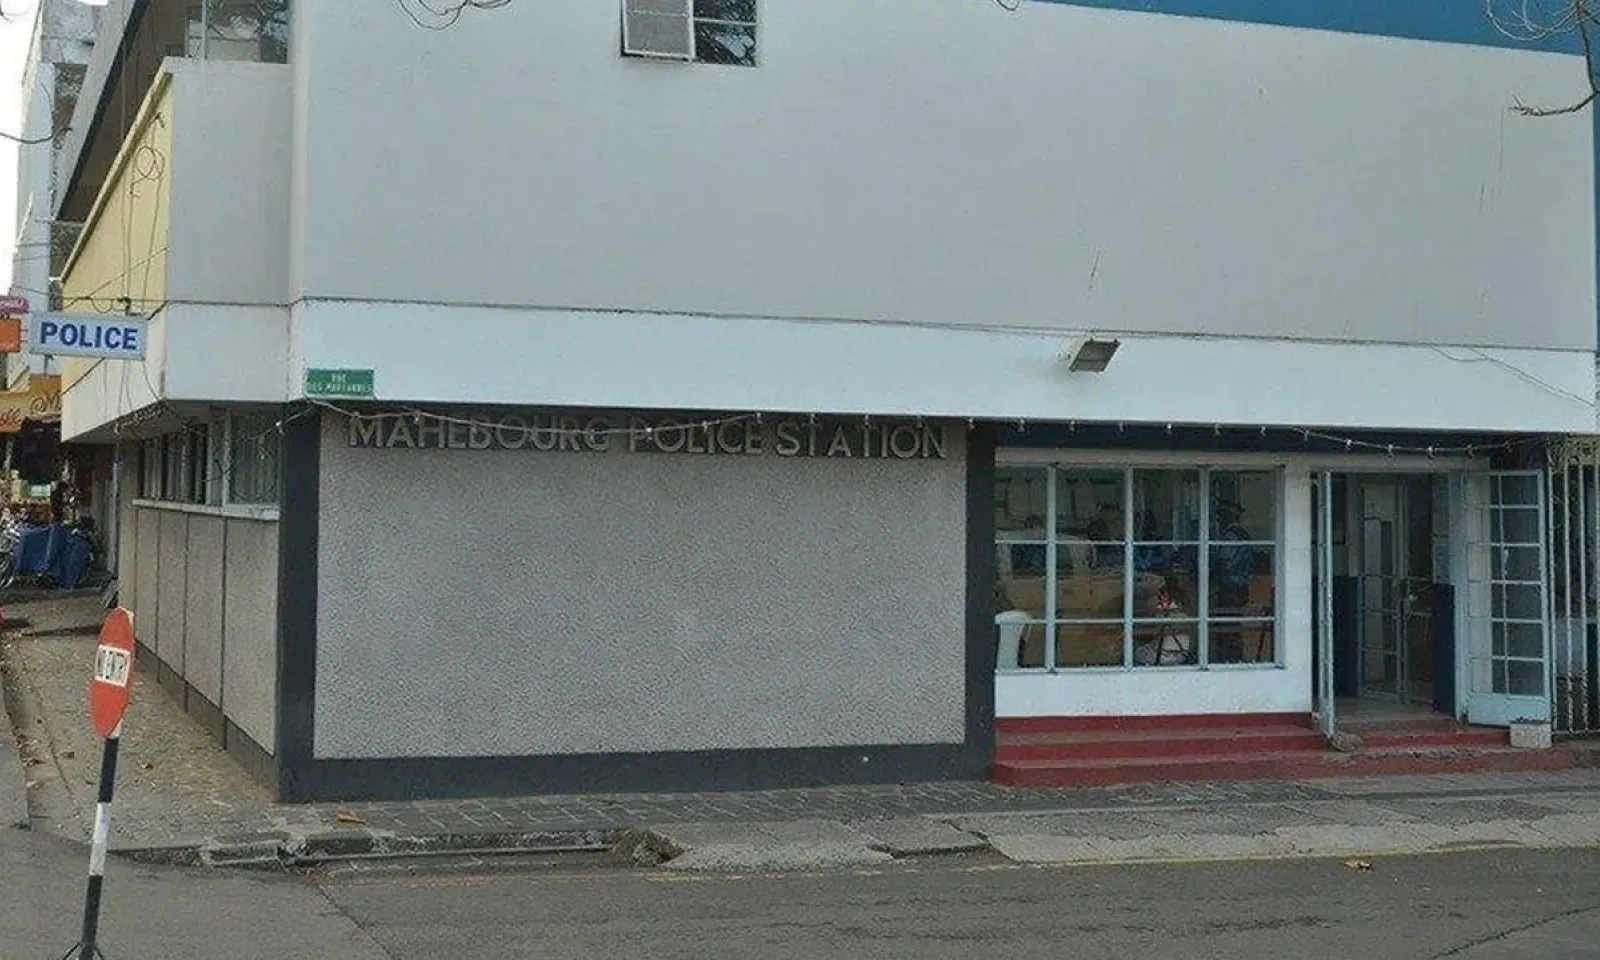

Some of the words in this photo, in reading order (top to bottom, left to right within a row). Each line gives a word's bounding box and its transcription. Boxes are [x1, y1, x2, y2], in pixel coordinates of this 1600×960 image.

[40, 321, 139, 350] POLICE
[349, 411, 611, 451] MAHEBOURG
[629, 417, 763, 455] POLICE
[776, 416, 947, 459] STATION
